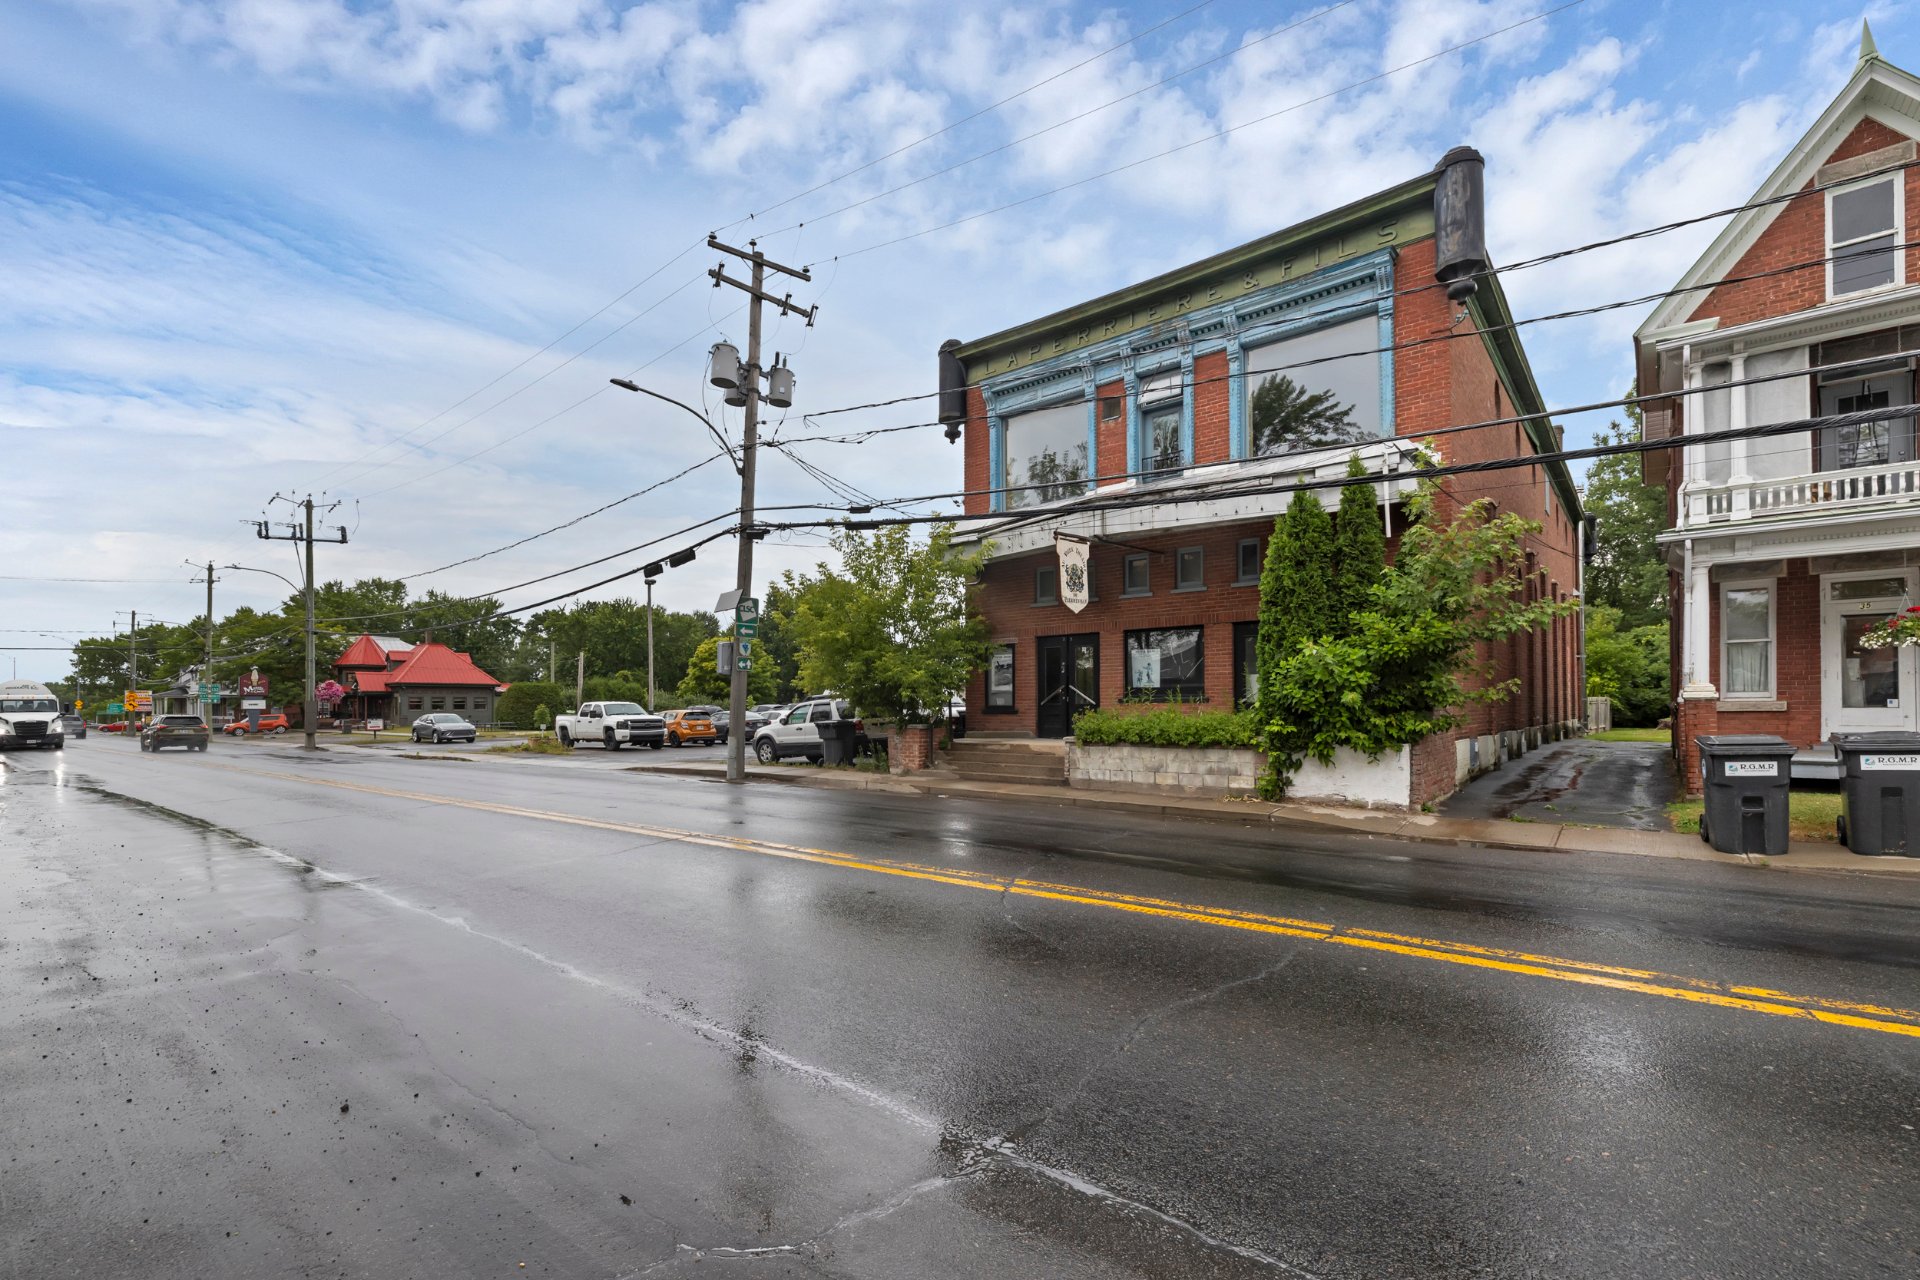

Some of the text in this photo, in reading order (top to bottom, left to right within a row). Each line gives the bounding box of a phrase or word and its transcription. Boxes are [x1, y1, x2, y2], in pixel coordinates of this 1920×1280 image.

[1242, 272, 1260, 290] &
[1281, 223, 1398, 279] FILS
[738, 604, 755, 613] CLSC
